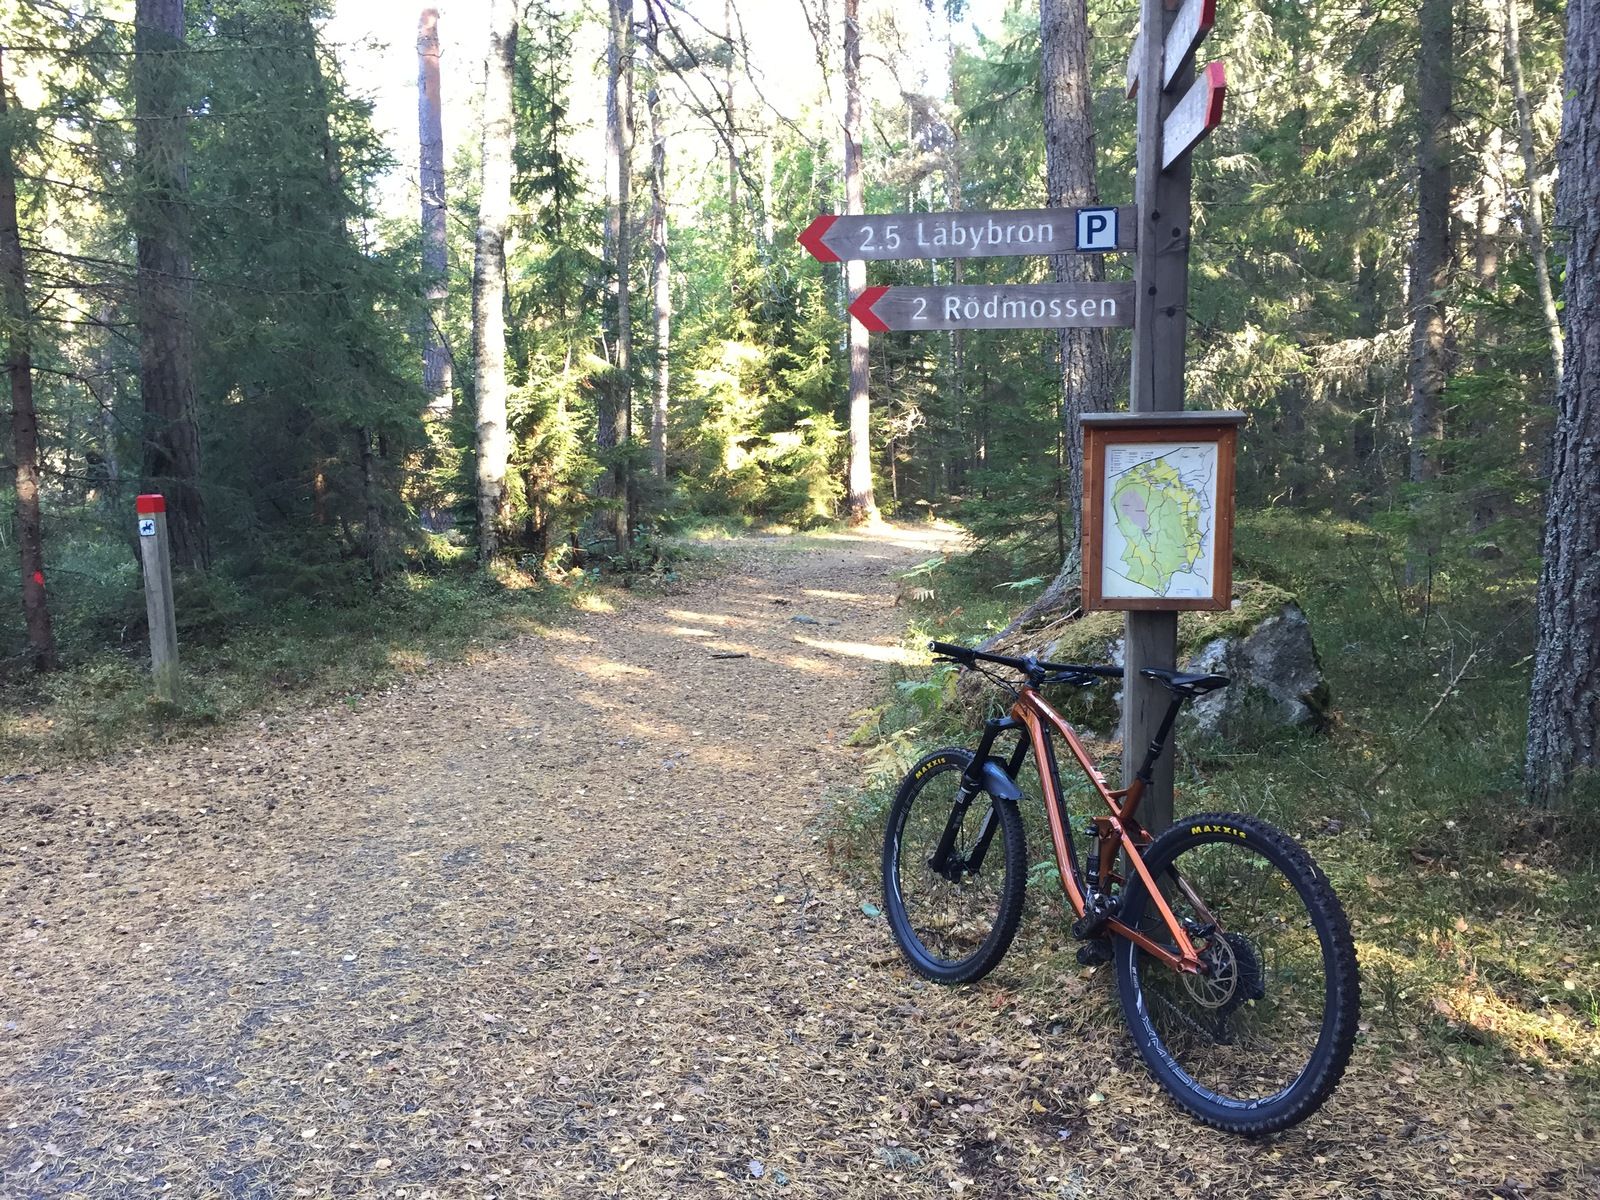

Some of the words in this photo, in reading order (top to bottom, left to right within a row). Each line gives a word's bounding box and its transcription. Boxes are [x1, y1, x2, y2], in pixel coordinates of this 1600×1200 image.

[859, 225, 900, 251] 2.5
[917, 219, 1053, 250] Läbybron
[1087, 214, 1107, 245] P
[911, 297, 927, 320] 2
[944, 295, 1116, 320] Rödmossen
[915, 757, 946, 780] MAXXIS
[1191, 824, 1247, 839] MAXXIS
